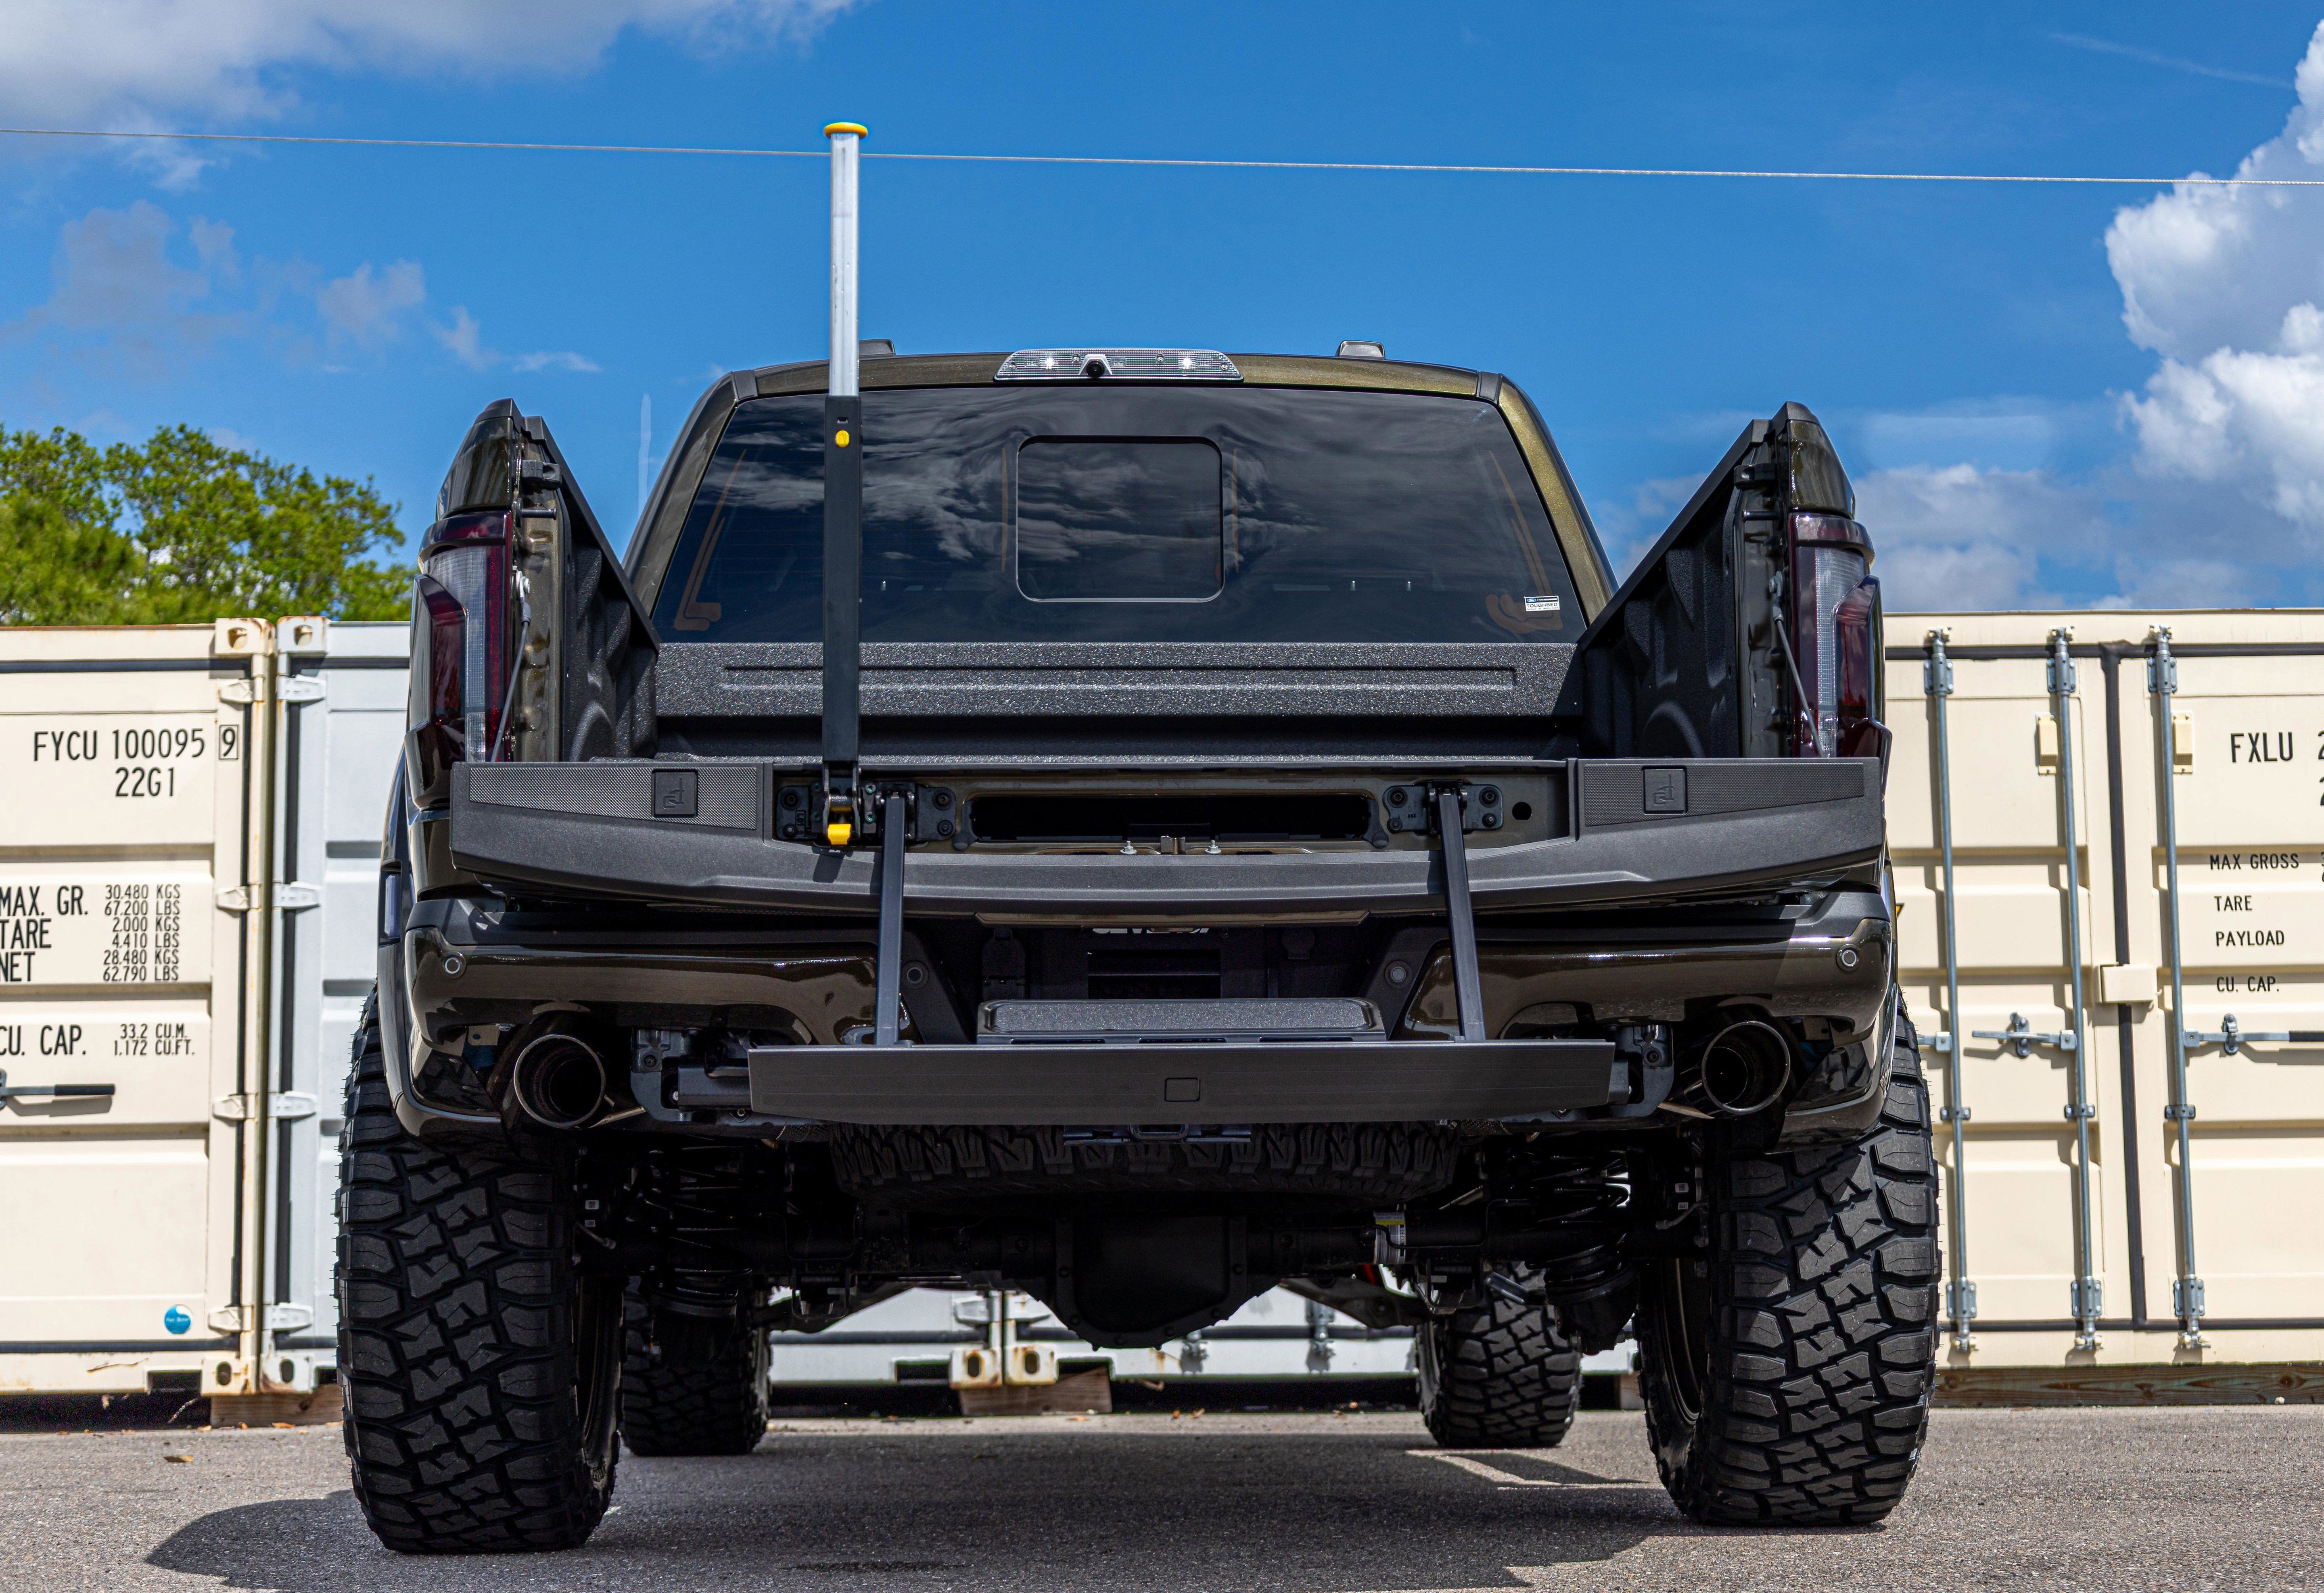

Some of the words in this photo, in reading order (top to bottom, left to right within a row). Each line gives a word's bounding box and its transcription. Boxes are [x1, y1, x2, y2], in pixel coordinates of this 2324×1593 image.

[34, 731, 97, 761] FYCU
[113, 729, 204, 759] 100095
[222, 727, 236, 756] 9
[2231, 732, 2293, 763] FXLU
[115, 767, 173, 797] 22G1
[2210, 854, 2241, 869] MAX
[2250, 853, 2299, 869] GROSS
[157, 885, 180, 898] KGS
[0, 886, 44, 916] MAX.
[57, 885, 88, 915] GR.
[156, 900, 180, 915] LBS
[2214, 896, 2252, 911] TARE
[156, 917, 179, 931] KGS
[0, 919, 51, 949] TARE
[155, 932, 179, 948] LBS
[2216, 931, 2284, 946] PAYLOAD
[155, 949, 178, 964] KGS
[0, 951, 35, 982] NET
[155, 965, 178, 981] LBS
[2217, 976, 2238, 992] CU.
[2248, 976, 2279, 992] CAP.
[121, 1024, 147, 1039] 33.2
[40, 1025, 86, 1055] CAP.
